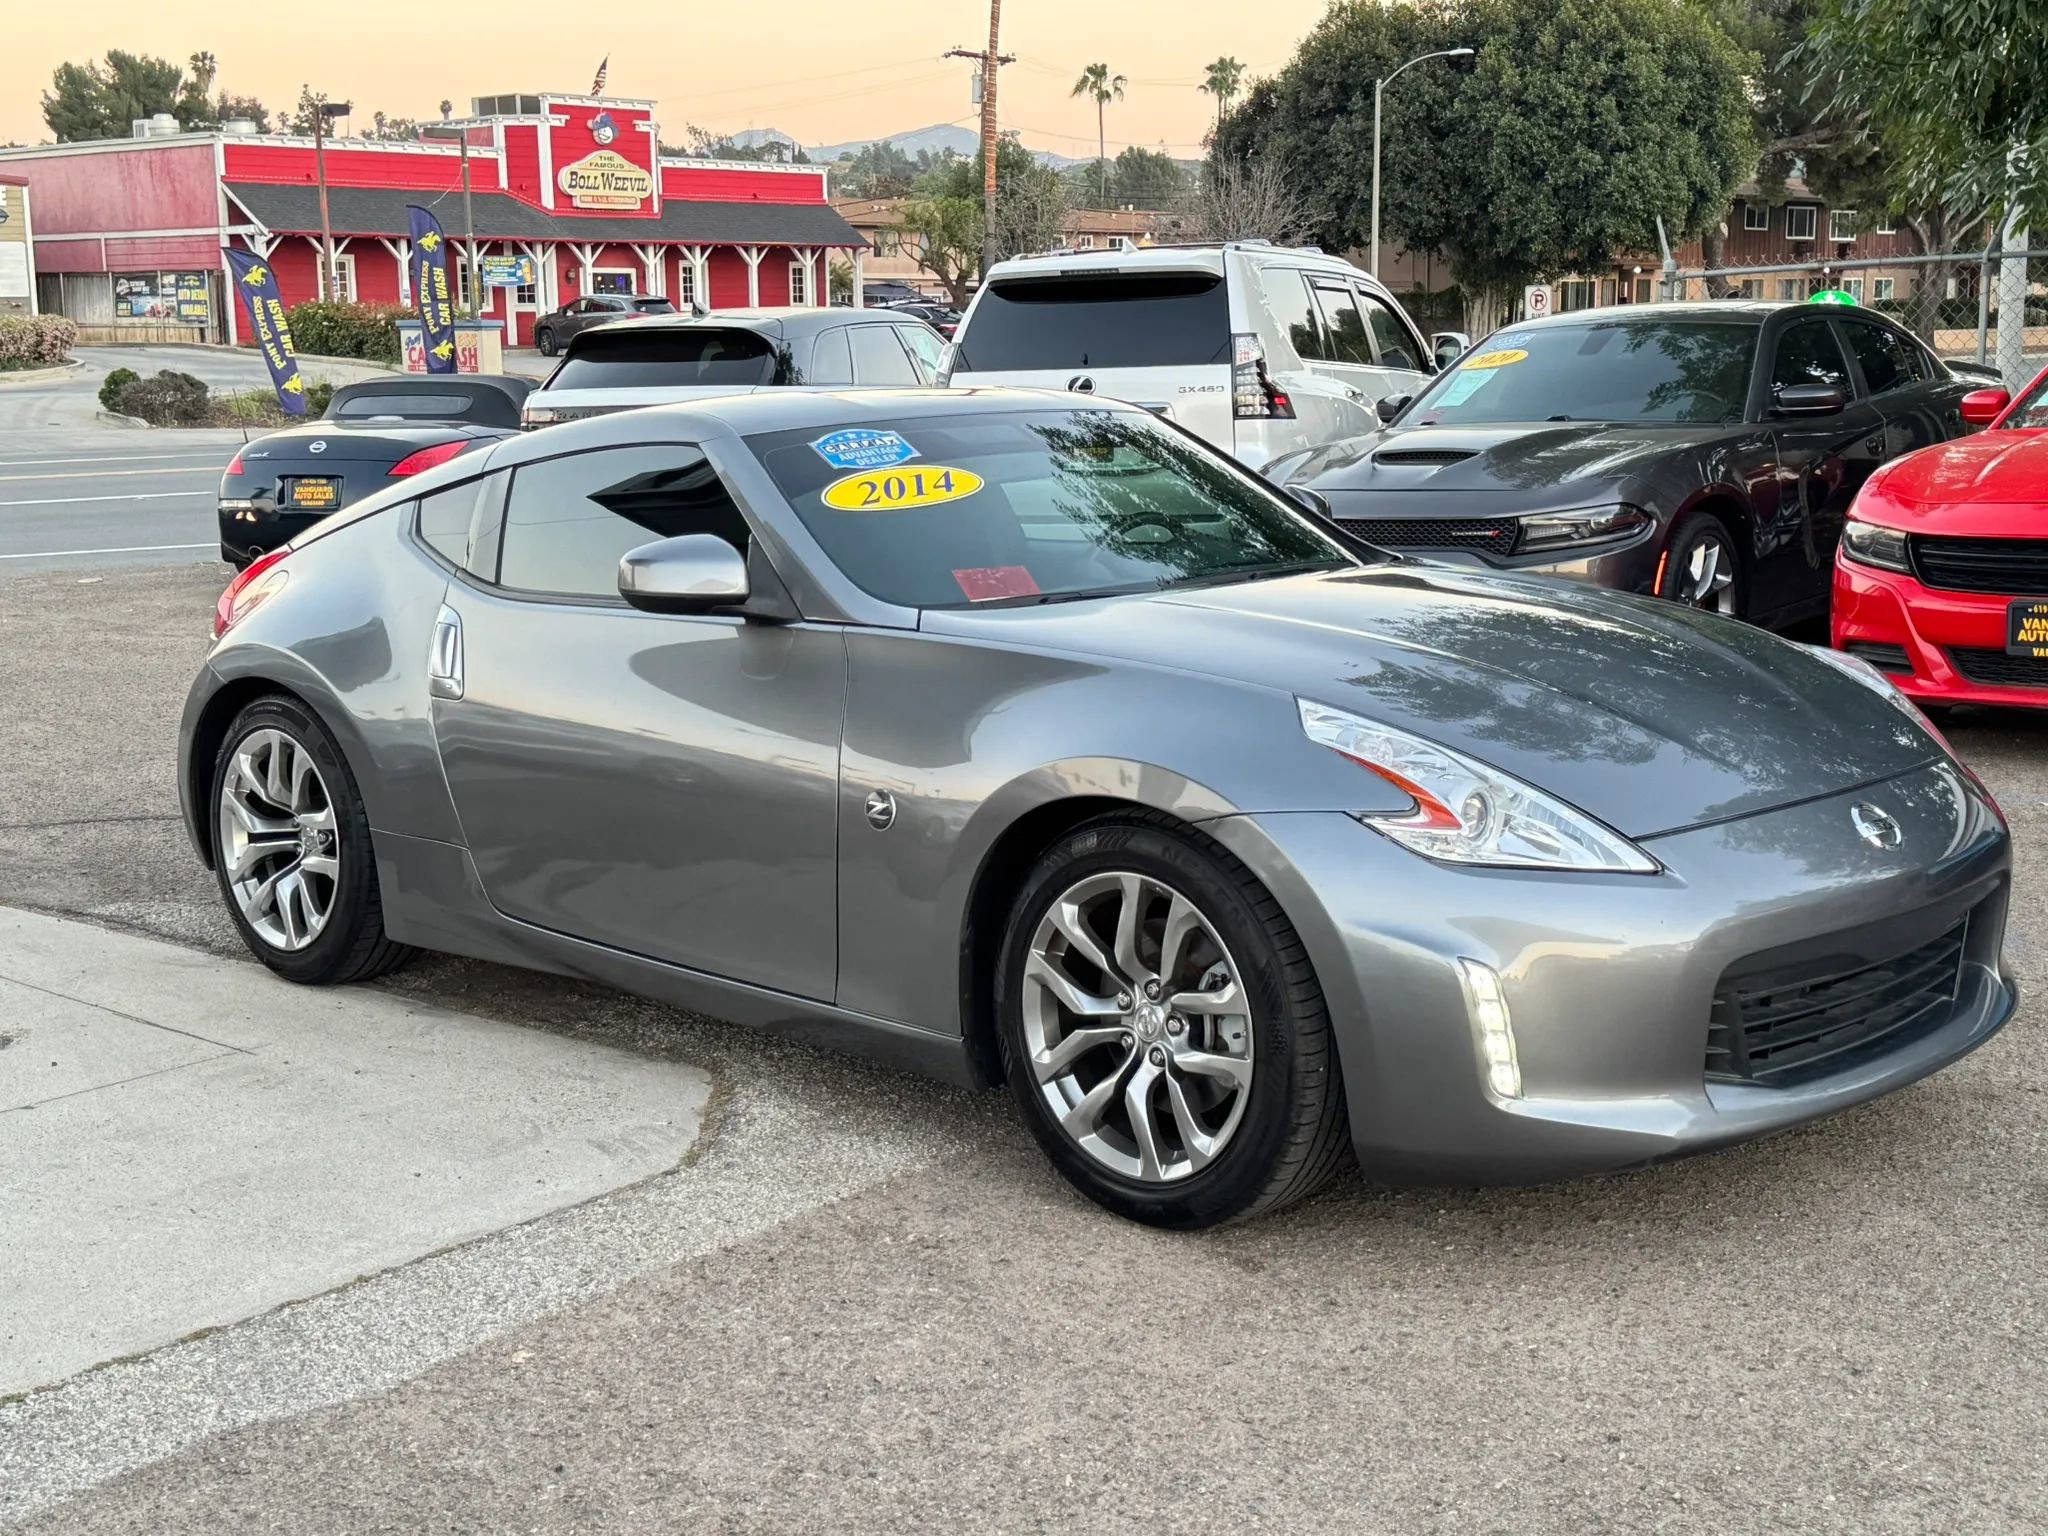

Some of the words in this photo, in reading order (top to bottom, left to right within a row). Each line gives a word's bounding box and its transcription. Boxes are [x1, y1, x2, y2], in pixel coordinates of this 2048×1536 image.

[420, 260, 431, 304] EXPRESS
[433, 267, 449, 300] WASH
[253, 296, 273, 341] EXPRESS
[266, 299, 288, 332] WASH
[423, 306, 439, 335] PONY
[438, 303, 451, 325] CAR
[265, 342, 286, 370] PONY
[280, 334, 295, 357] CAR
[408, 346, 426, 364] CA
[823, 437, 899, 454] CARFAX
[838, 446, 903, 461] ADVANTAGE
[856, 454, 898, 466] DEALER
[857, 470, 955, 506] 2014
